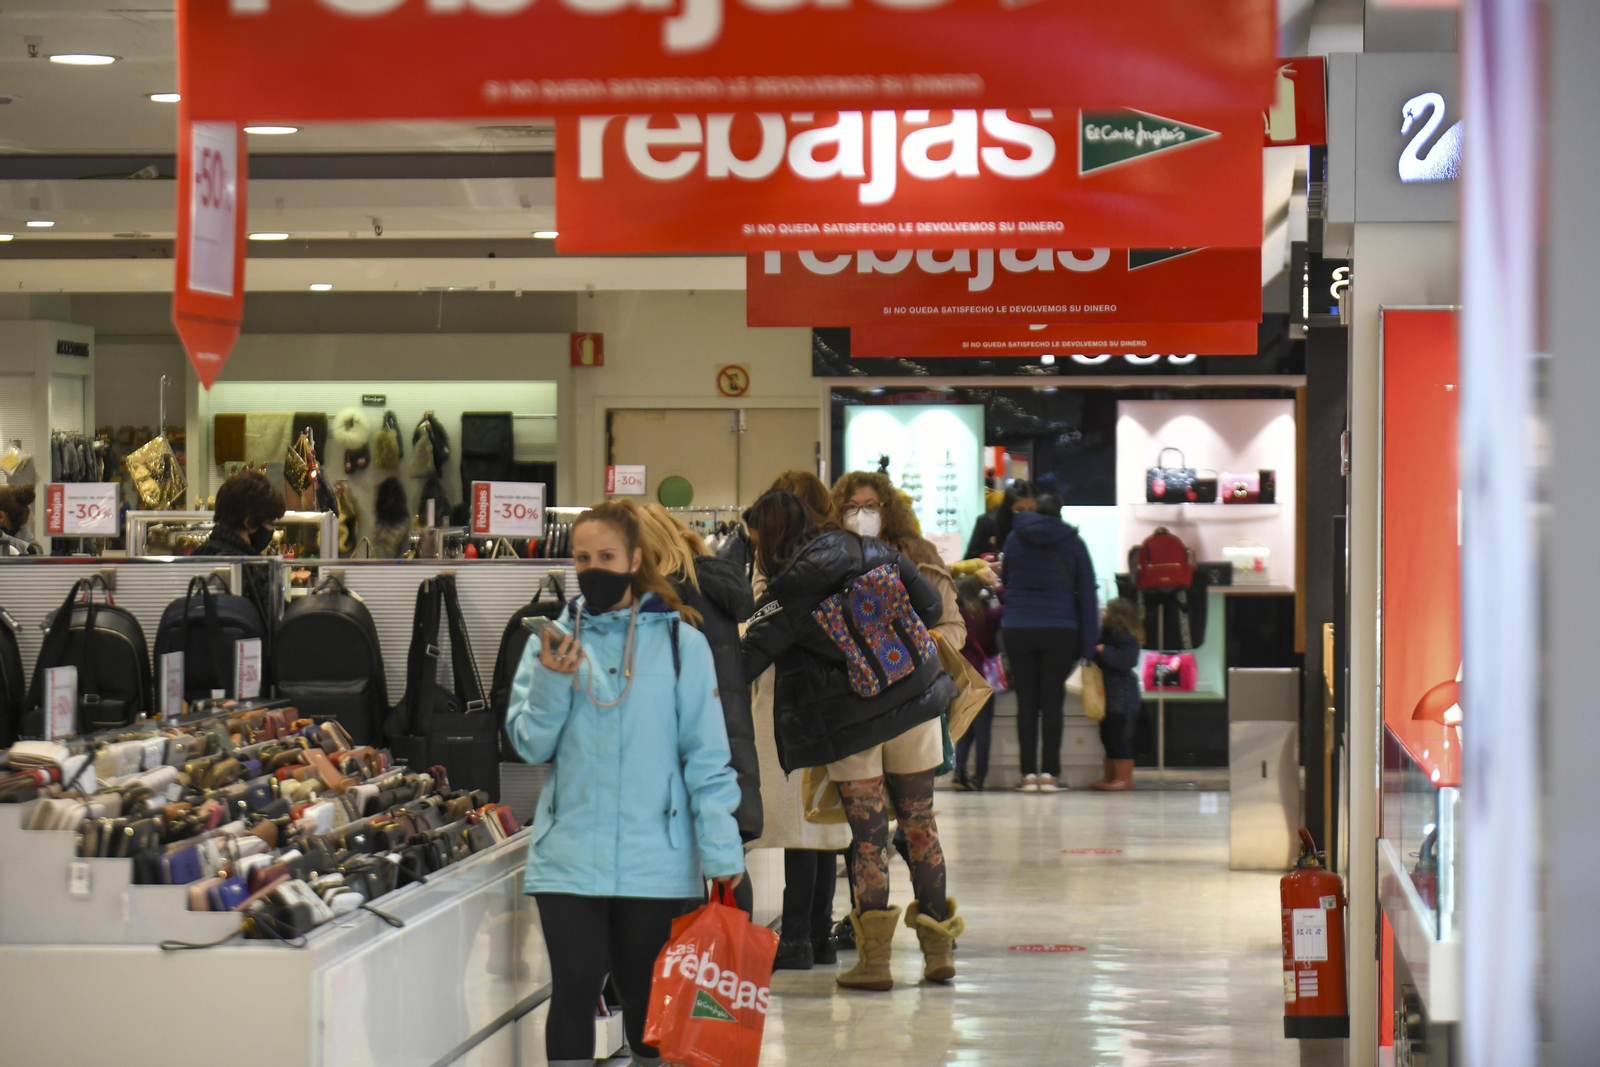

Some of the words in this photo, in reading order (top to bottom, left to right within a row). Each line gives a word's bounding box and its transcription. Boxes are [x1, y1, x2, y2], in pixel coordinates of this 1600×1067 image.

[579, 109, 1056, 205] rebajas
[743, 223, 755, 234] SI
[757, 223, 776, 234] NO
[778, 223, 821, 234] QUEDA
[822, 222, 896, 233] SATISFECHO
[898, 222, 913, 232] LE
[916, 221, 996, 232] DEVOLVEMOS
[999, 221, 1015, 231] SU
[1018, 220, 1064, 231] DINERO
[883, 306, 892, 314] SI
[894, 306, 907, 314] NO
[909, 306, 939, 314] QUEDA
[941, 305, 995, 313] SATISFECHO
[996, 305, 1007, 313] LE
[1009, 305, 1067, 313] DEVOLVEMOS
[1069, 304, 1082, 312] SU
[1083, 304, 1118, 312] DINERO
[616, 475, 643, 486] -30%
[50, 491, 63, 529] rebajas
[67, 503, 114, 520] -30%
[476, 489, 489, 528] rebajas
[493, 502, 539, 520] -30%
